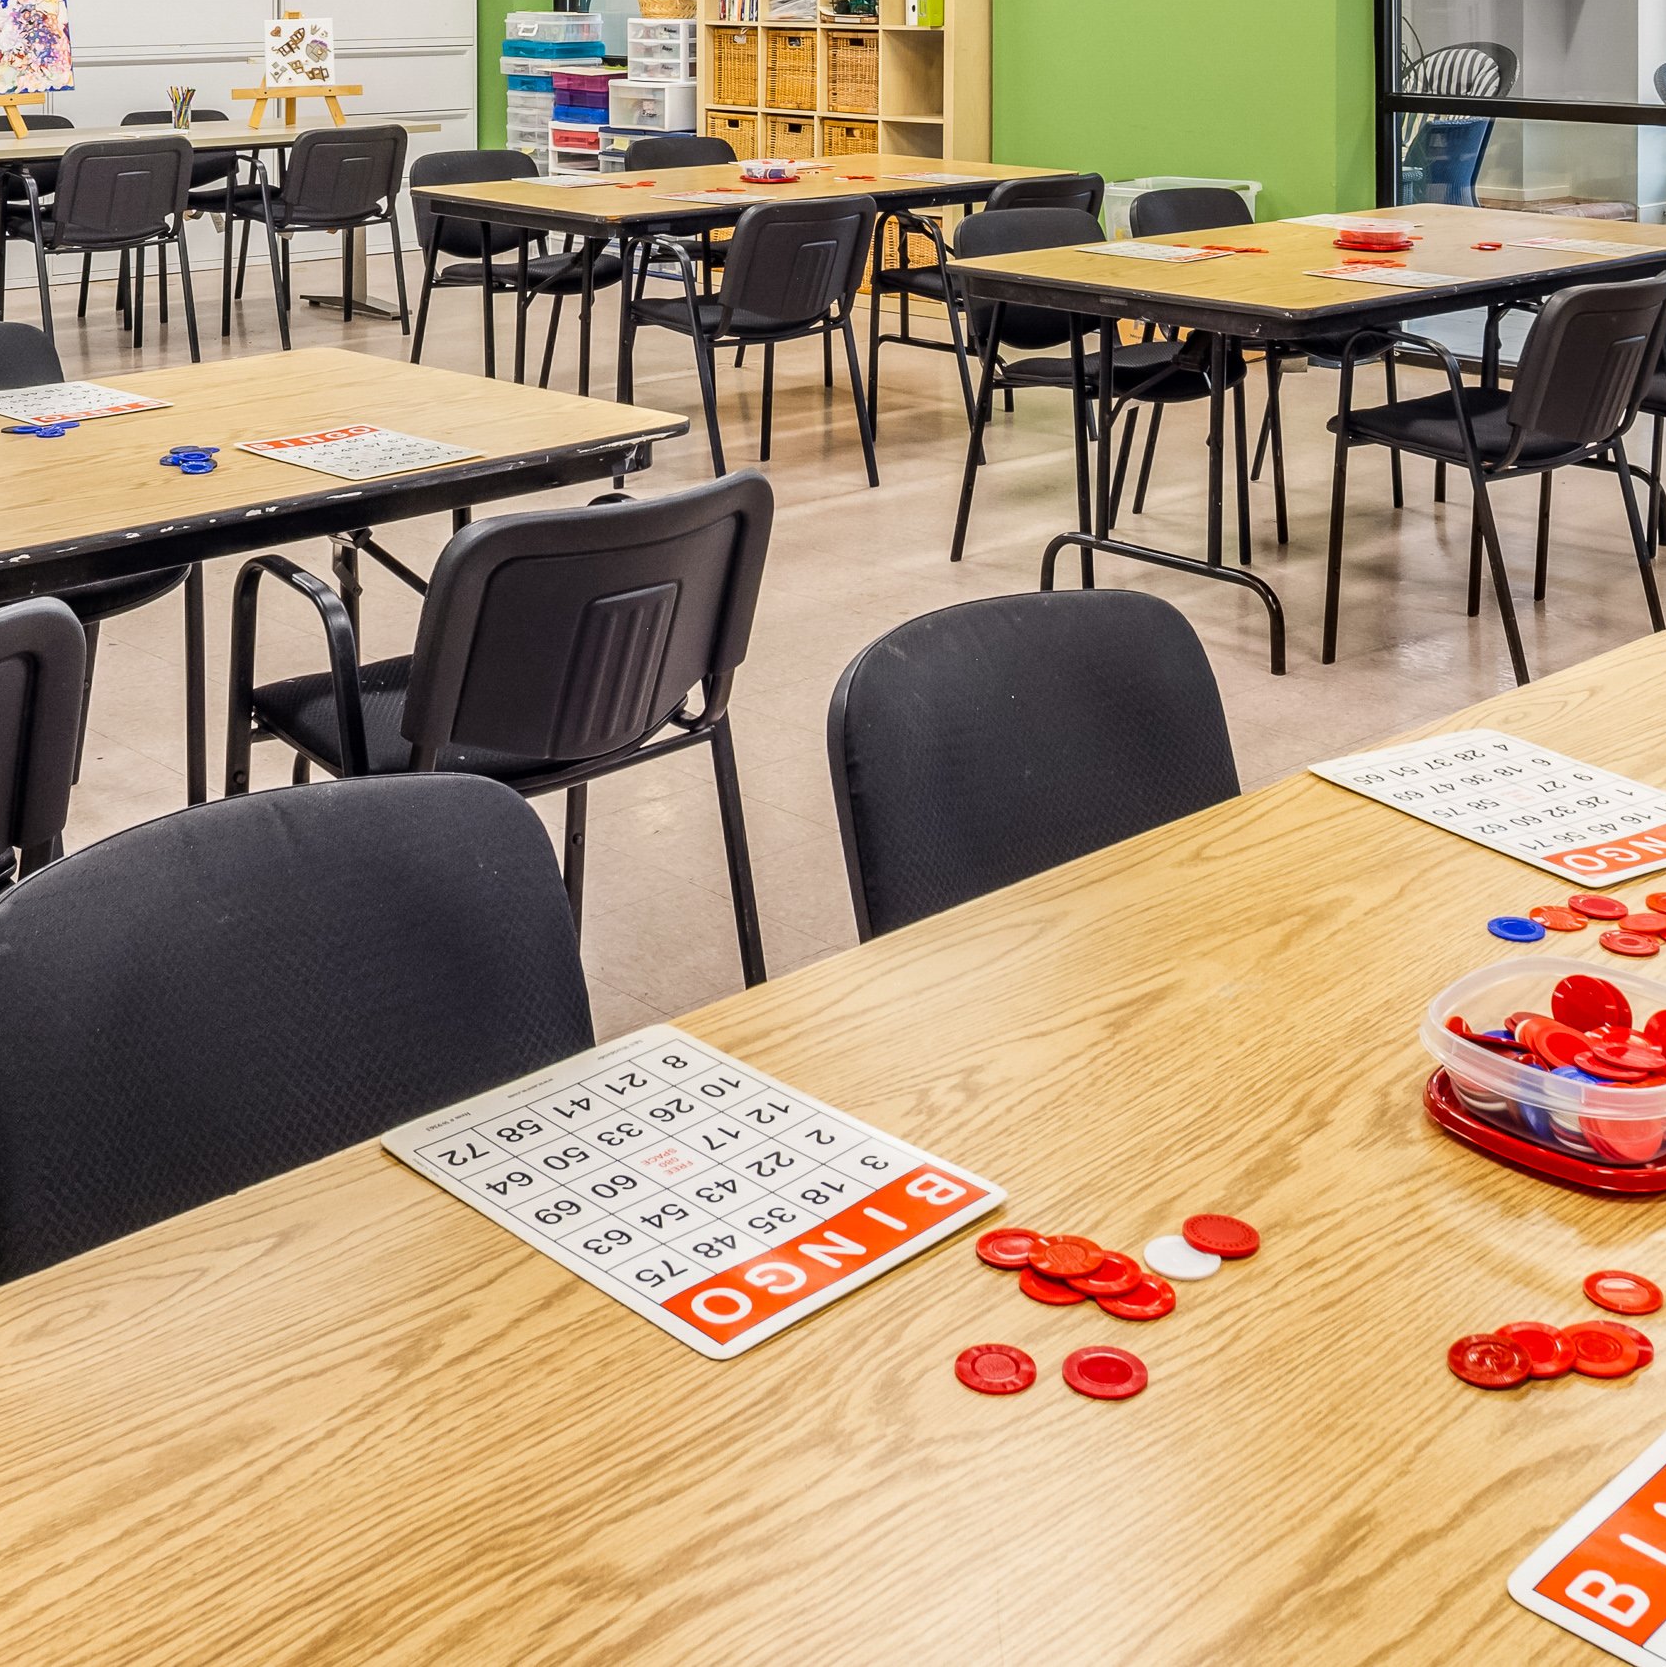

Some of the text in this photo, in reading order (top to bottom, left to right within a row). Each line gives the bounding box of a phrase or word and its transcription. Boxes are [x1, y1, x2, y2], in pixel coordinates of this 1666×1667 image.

[250, 426, 372, 451] BINGO
[1352, 743, 1508, 785] 4 28 37 51 65
[1392, 758, 1551, 800] 6 18 36 47 69
[1572, 773, 1593, 781] 9
[1536, 780, 1566, 792] 27
[1466, 798, 1500, 810] 58
[1575, 795, 1609, 808] 26
[1431, 806, 1466, 818] 75
[1541, 805, 1576, 818] 32
[1620, 812, 1651, 824] 16
[1509, 815, 1542, 826] 60
[1472, 823, 1508, 834] 62
[1586, 822, 1617, 834] 45
[1552, 831, 1586, 842] 56
[1518, 839, 1553, 850] 71
[437, 1055, 687, 1165] 8 21 41 58 72
[702, 1102, 789, 1150] 12 17
[485, 1077, 740, 1195] 10 26 33 50 64
[640, 1147, 678, 1166] SPACE
[582, 1129, 834, 1254] 2 22 43 54 63
[534, 1174, 637, 1224] 60 69
[635, 1155, 888, 1287] 3 18 35 48 75
[690, 1170, 968, 1326] BINGO
